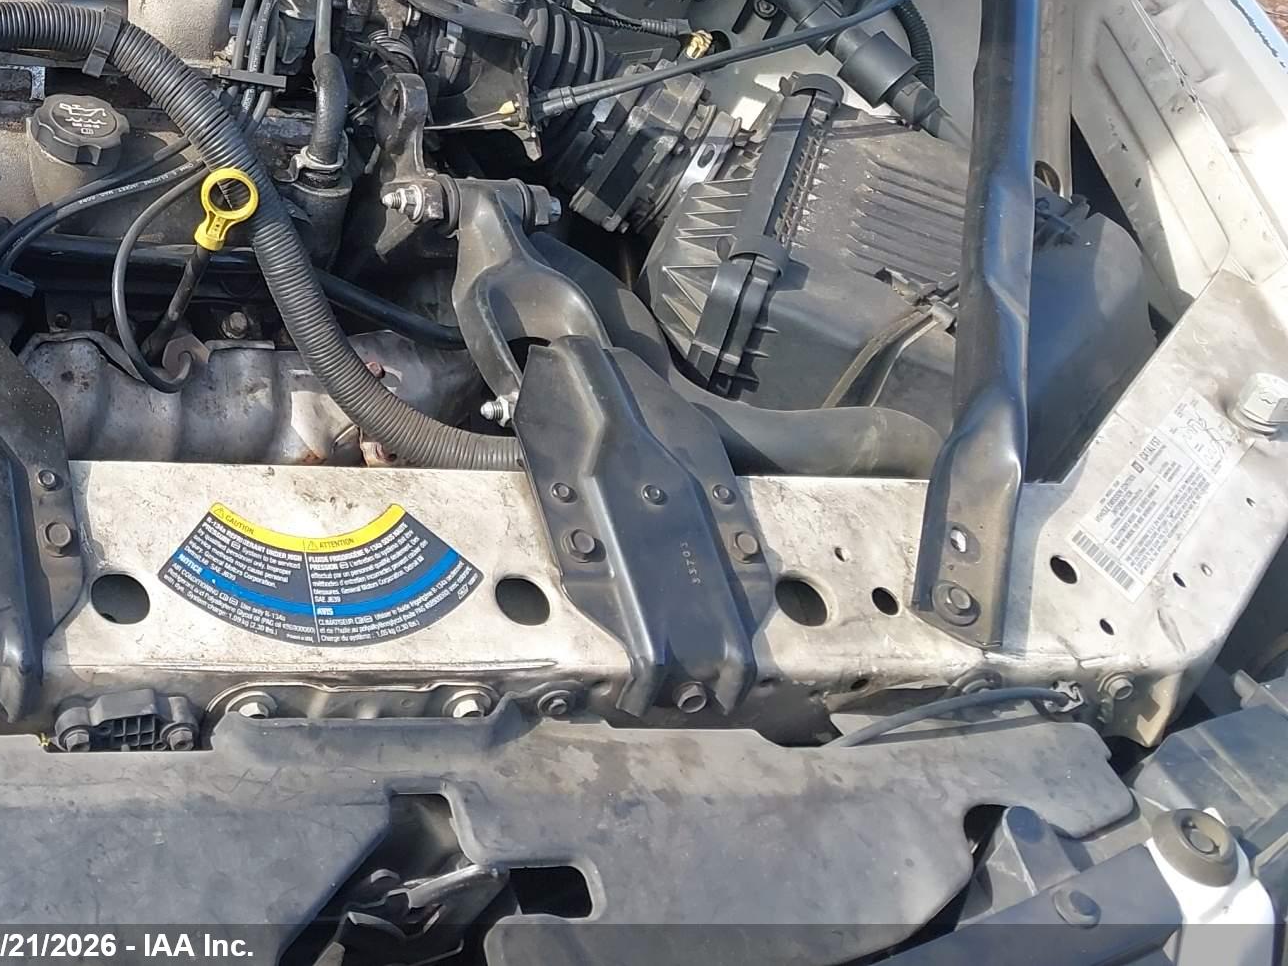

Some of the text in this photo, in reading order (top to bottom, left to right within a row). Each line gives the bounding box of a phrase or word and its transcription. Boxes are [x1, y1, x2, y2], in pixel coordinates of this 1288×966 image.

[1138, 435, 1162, 462] CATALYST
[224, 513, 254, 535] CAUTION
[318, 536, 355, 549] ATTENTION
[176, 553, 203, 575] NOTICE
[170, 561, 182, 572] AIR
[180, 567, 219, 597] CONDITIONING
[316, 607, 334, 615] AVIS
